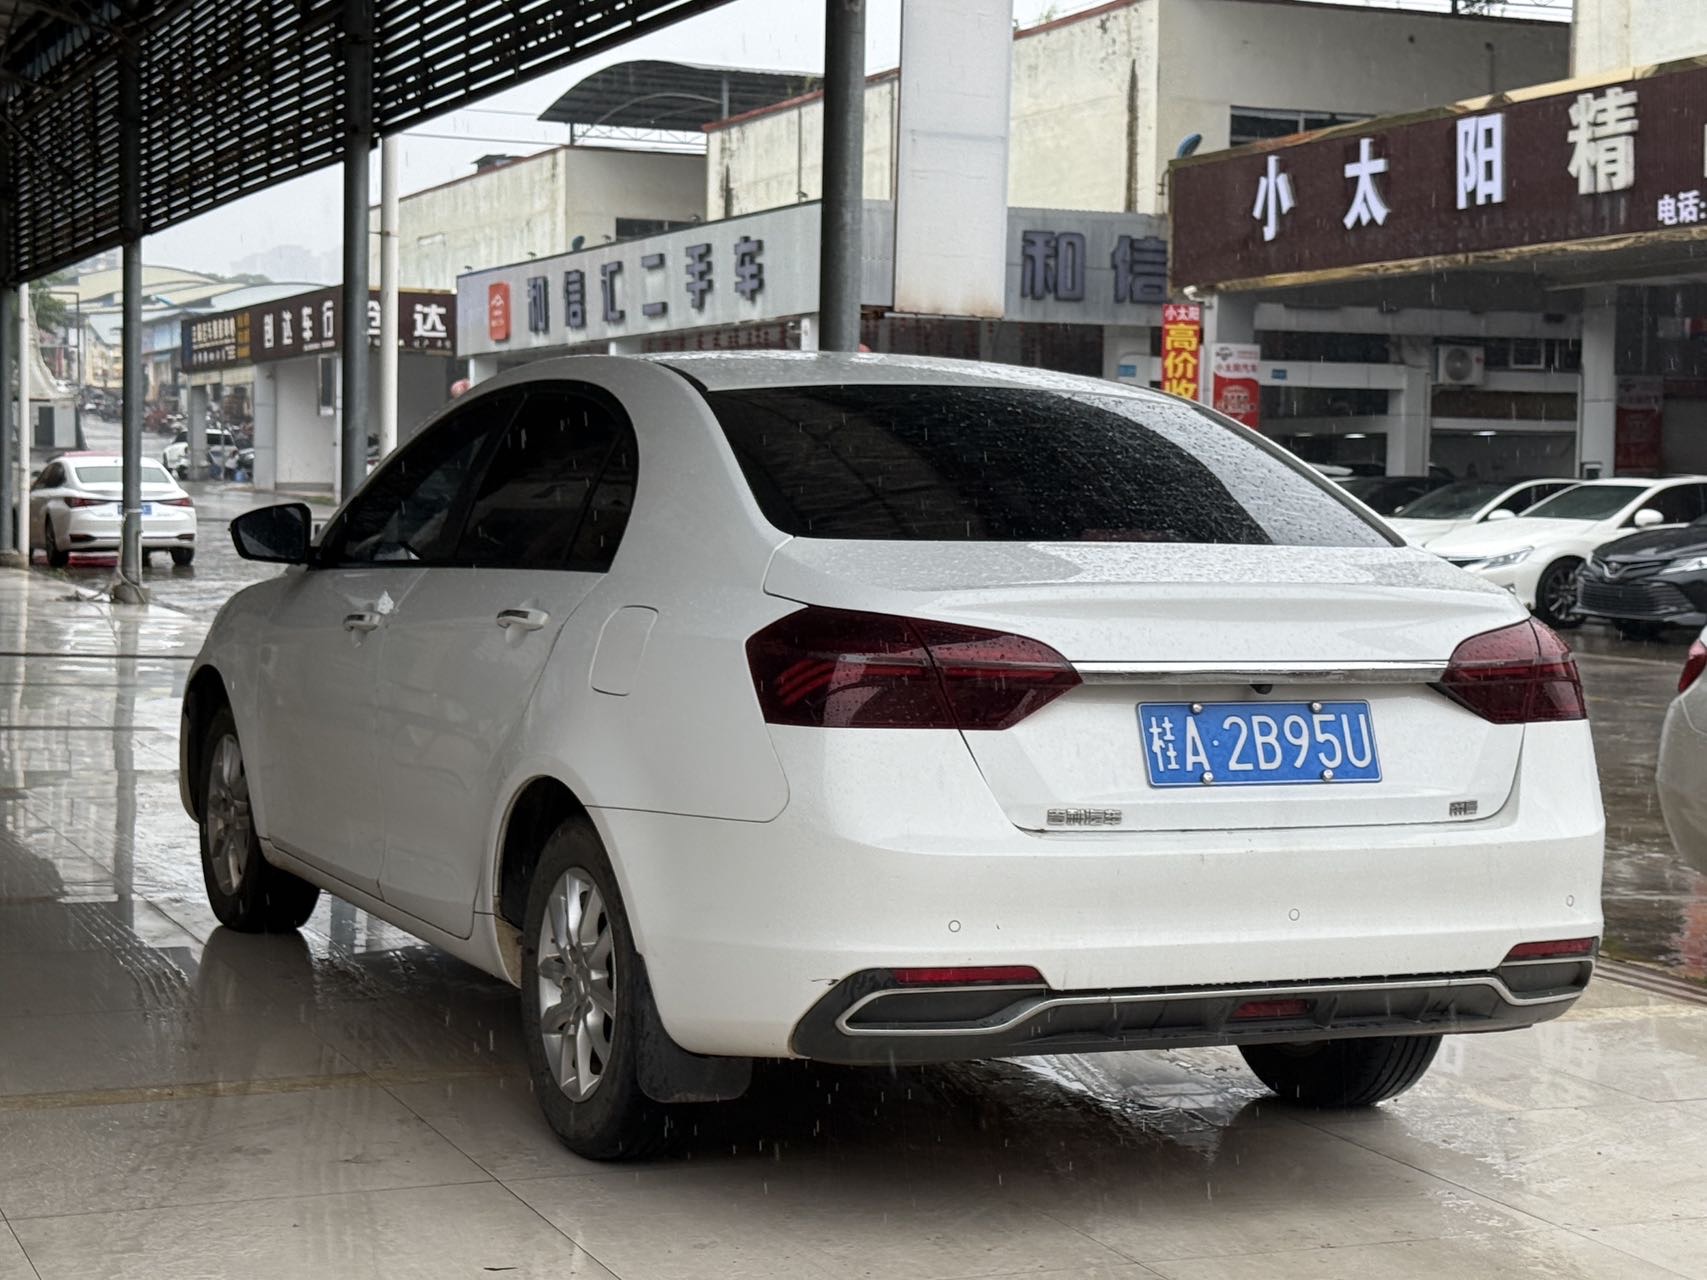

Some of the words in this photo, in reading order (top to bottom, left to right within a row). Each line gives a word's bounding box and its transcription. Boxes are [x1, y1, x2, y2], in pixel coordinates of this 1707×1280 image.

[1253, 87, 1707, 242] 小太阳精
[1658, 190, 1706, 225] 电话:
[527, 236, 764, 333] 和信汇二手车
[1021, 230, 1167, 304] 和信
[1165, 305, 1200, 321] 小太阳
